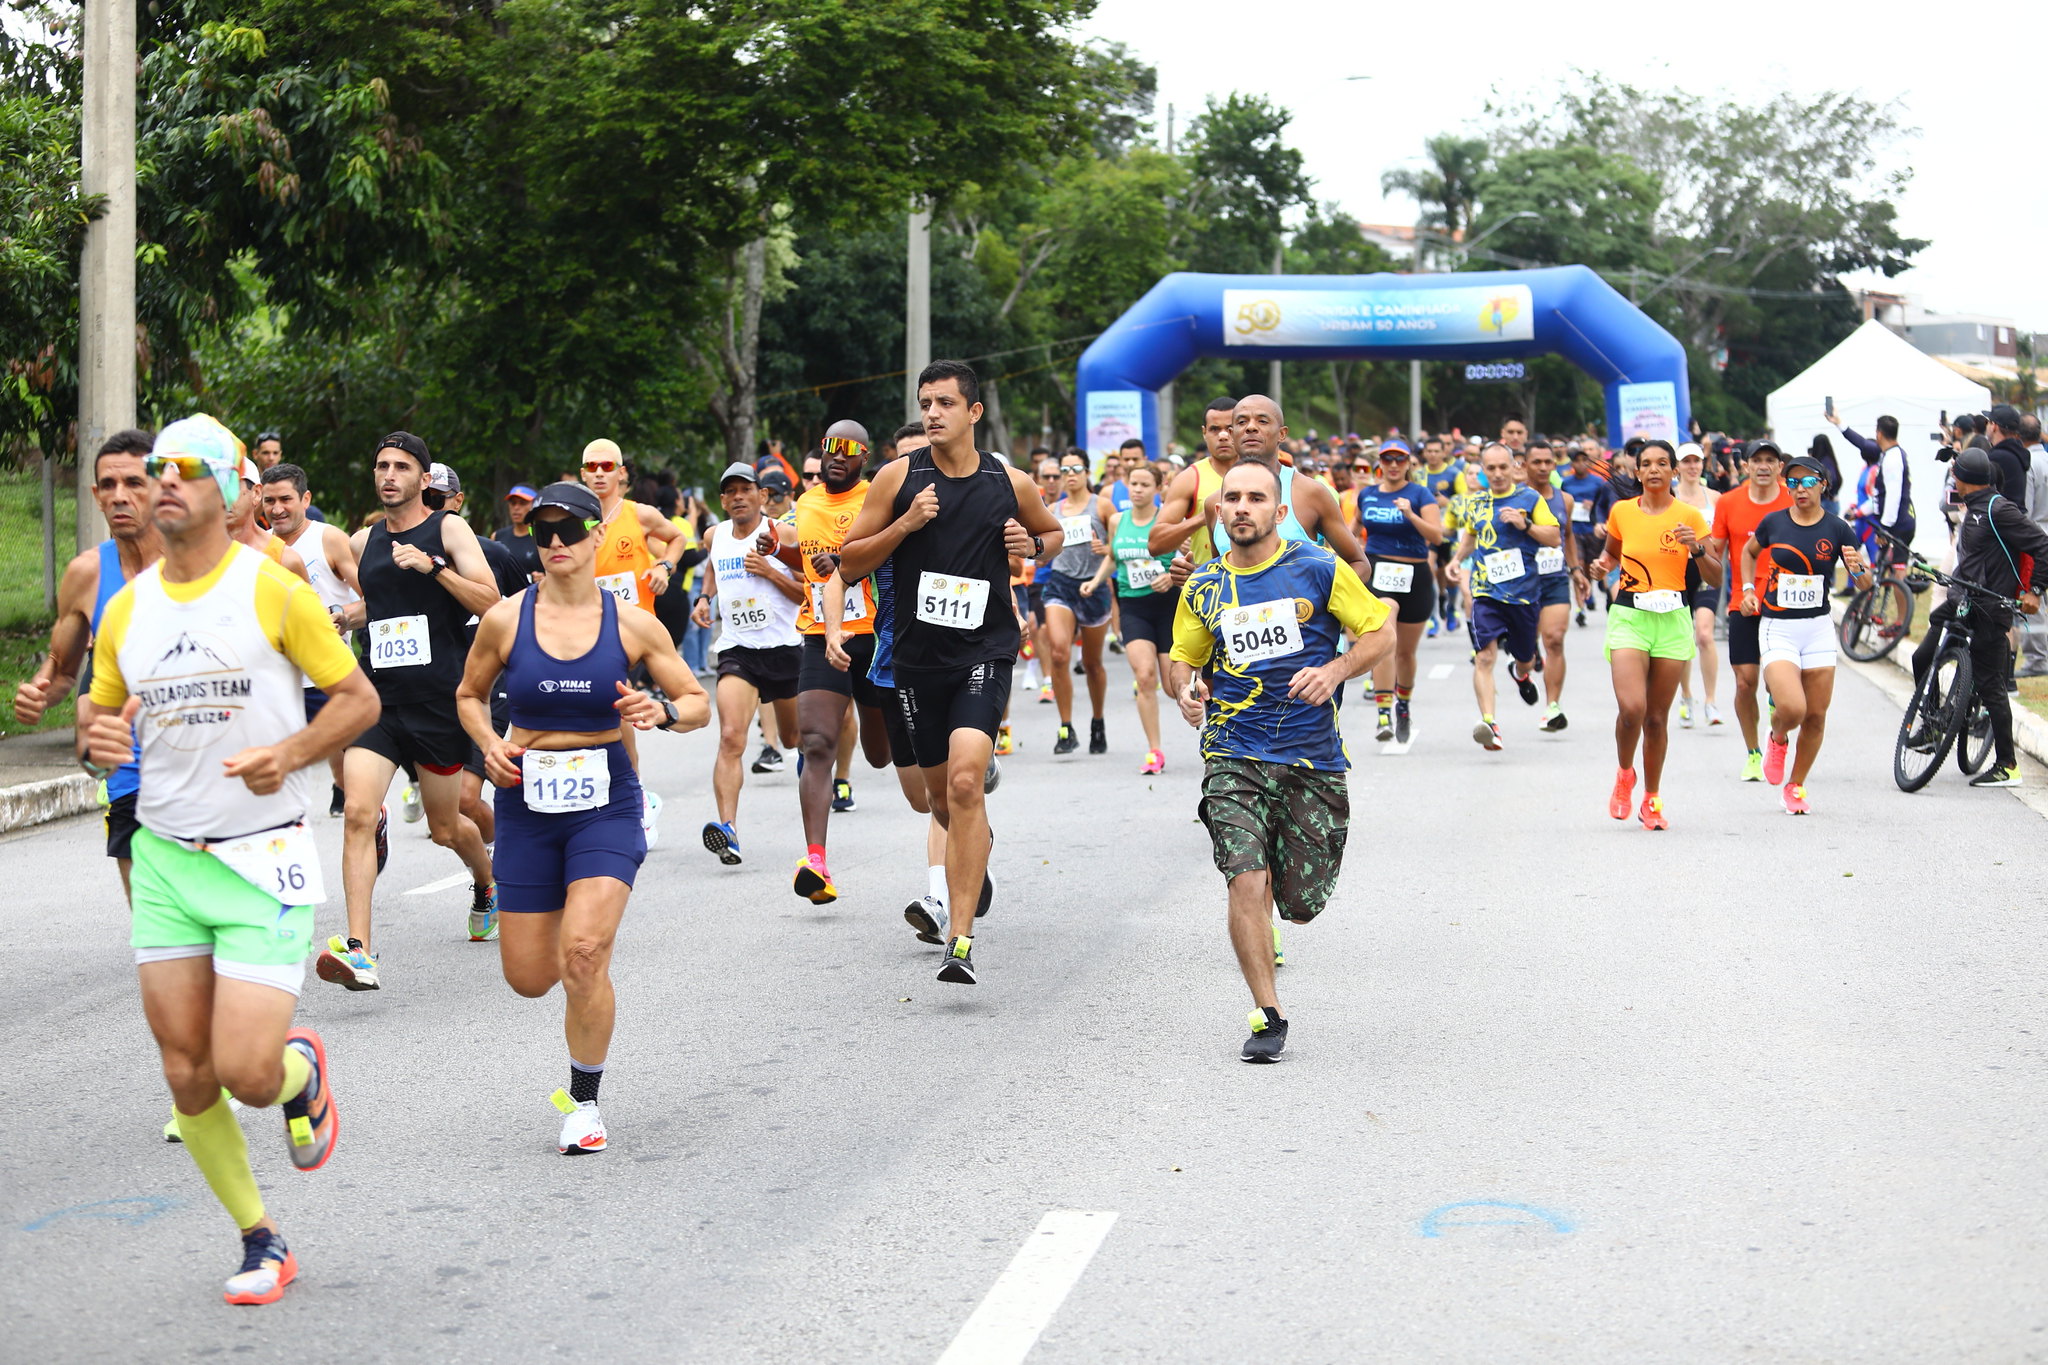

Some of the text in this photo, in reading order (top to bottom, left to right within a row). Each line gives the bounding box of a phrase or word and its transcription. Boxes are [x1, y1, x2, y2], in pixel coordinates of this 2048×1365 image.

[1396, 317, 1438, 331] ANOS
[1132, 568, 1159, 583] 5164
[1491, 561, 1518, 577] 5212
[1379, 575, 1406, 588] 5255
[1782, 589, 1816, 603] 1108
[925, 595, 971, 619] 5111
[732, 609, 766, 626] 5165
[1232, 625, 1288, 653] 5048
[376, 638, 419, 659] 1033
[211, 678, 252, 698] TEAM
[559, 680, 592, 689] VINAC
[533, 777, 595, 801] 1125
